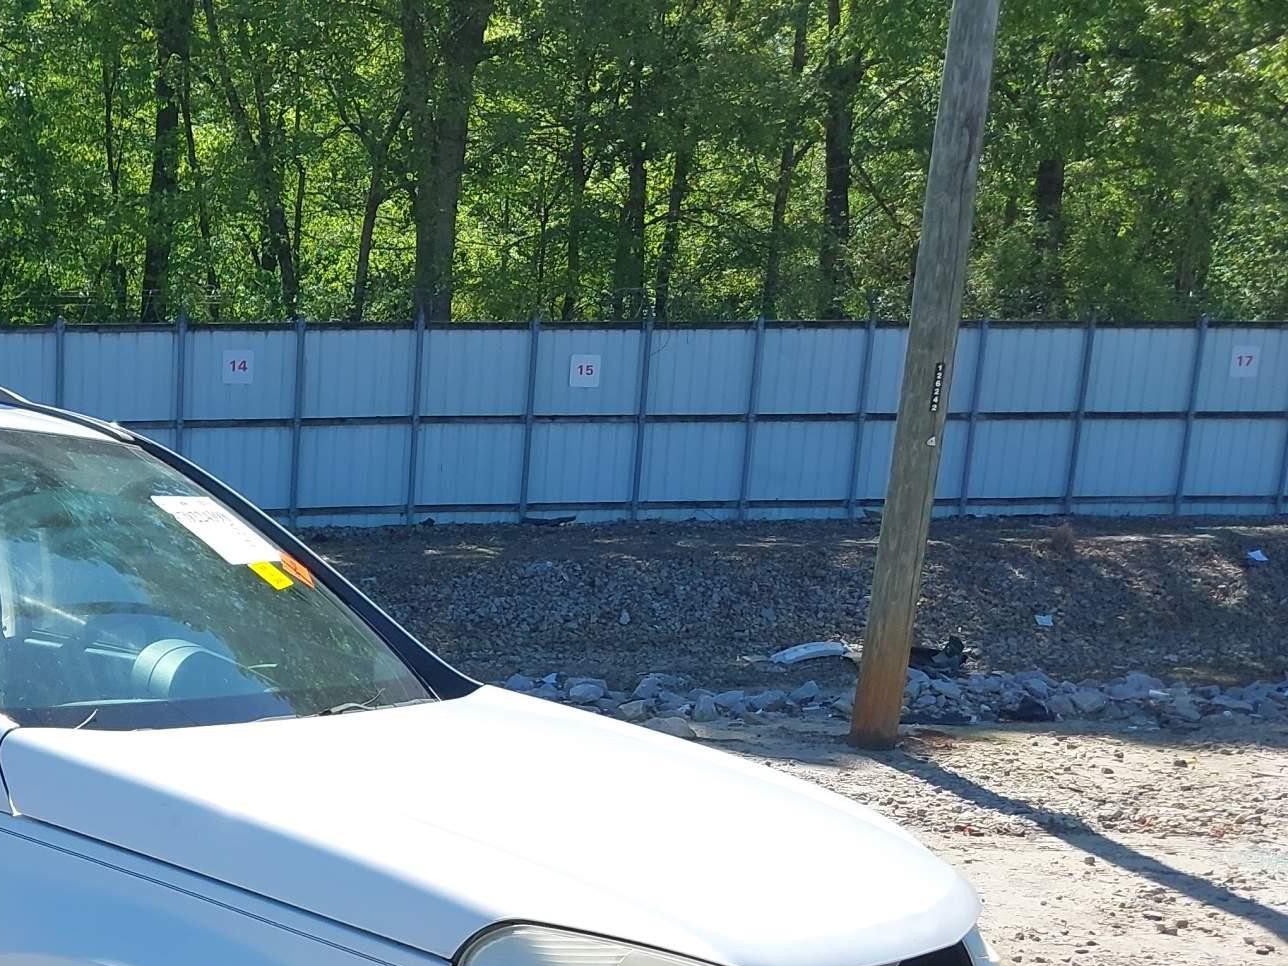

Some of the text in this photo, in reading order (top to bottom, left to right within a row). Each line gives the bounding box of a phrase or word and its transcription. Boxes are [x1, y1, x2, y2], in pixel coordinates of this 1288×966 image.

[229, 359, 248, 372] 14
[1237, 355, 1253, 367] 17
[578, 364, 594, 376] 15
[931, 364, 943, 411] 126242
